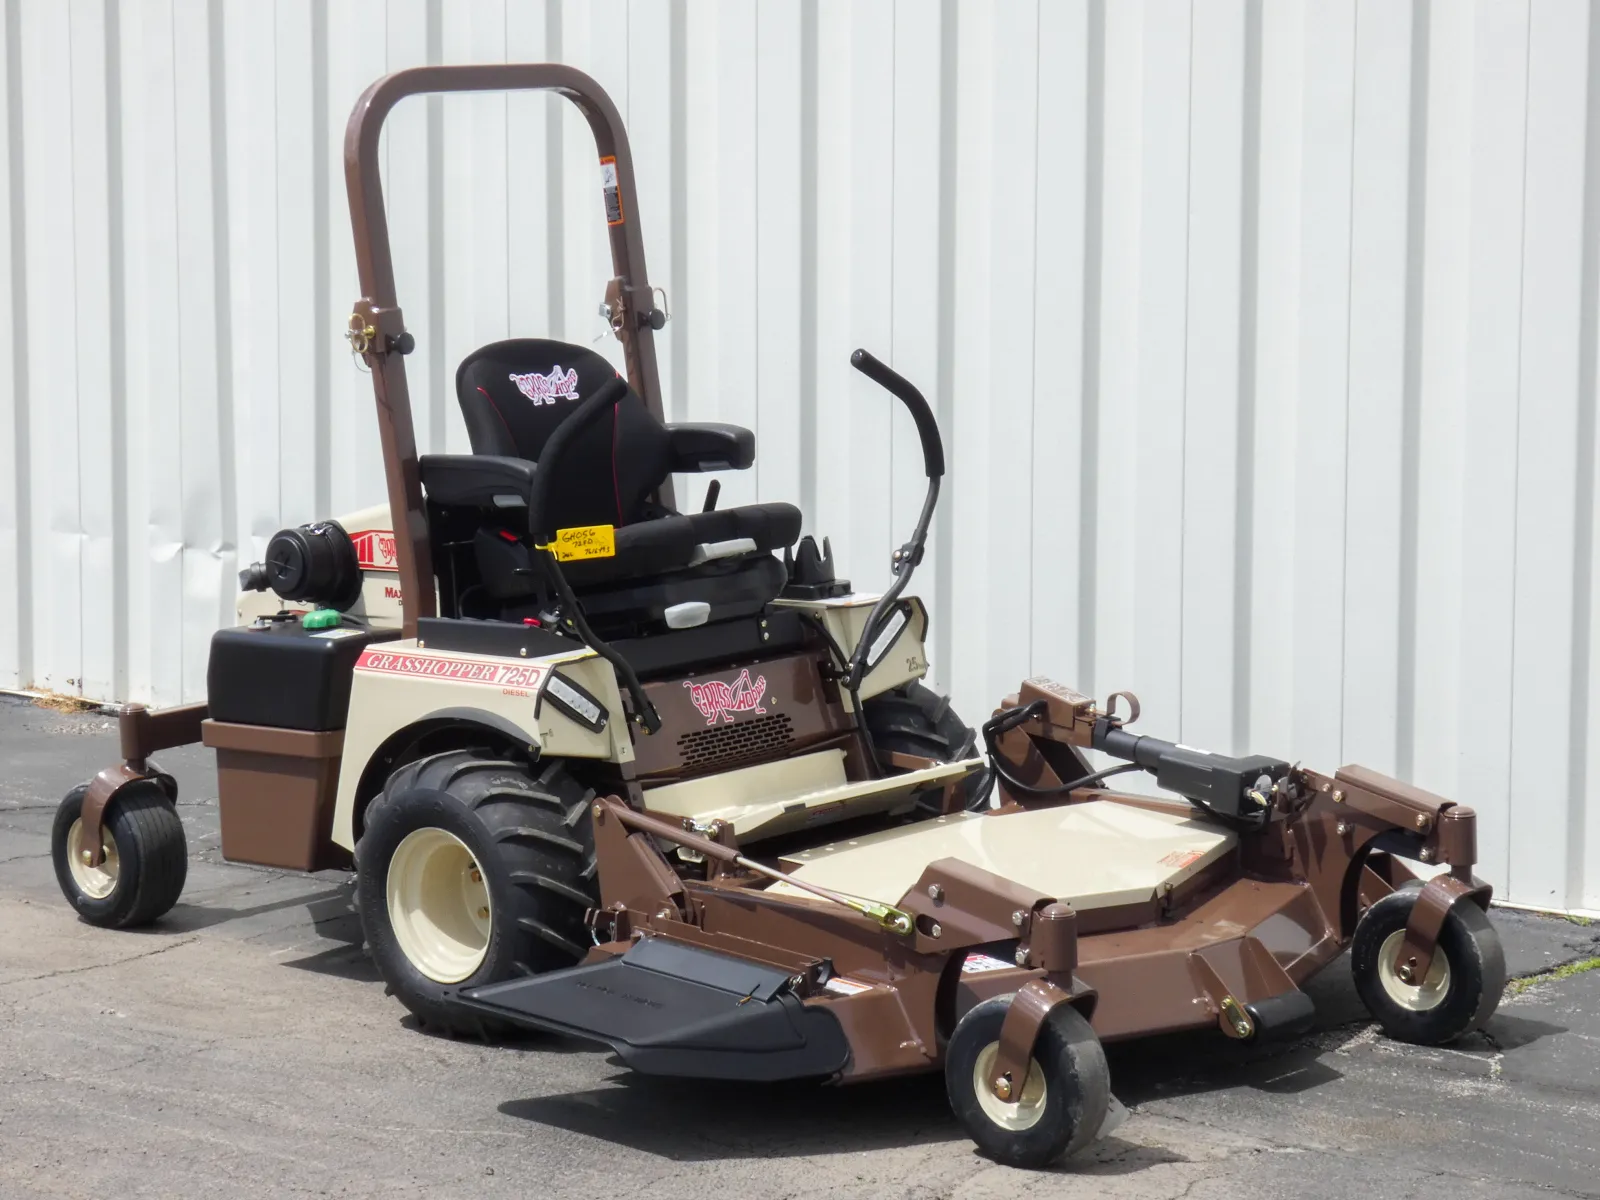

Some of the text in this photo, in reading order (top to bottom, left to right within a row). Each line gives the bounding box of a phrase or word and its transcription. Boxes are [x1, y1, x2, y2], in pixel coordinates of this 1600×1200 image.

[367, 653, 541, 687] GRASSHOPPER 725D
[502, 687, 530, 698] DIESEL
